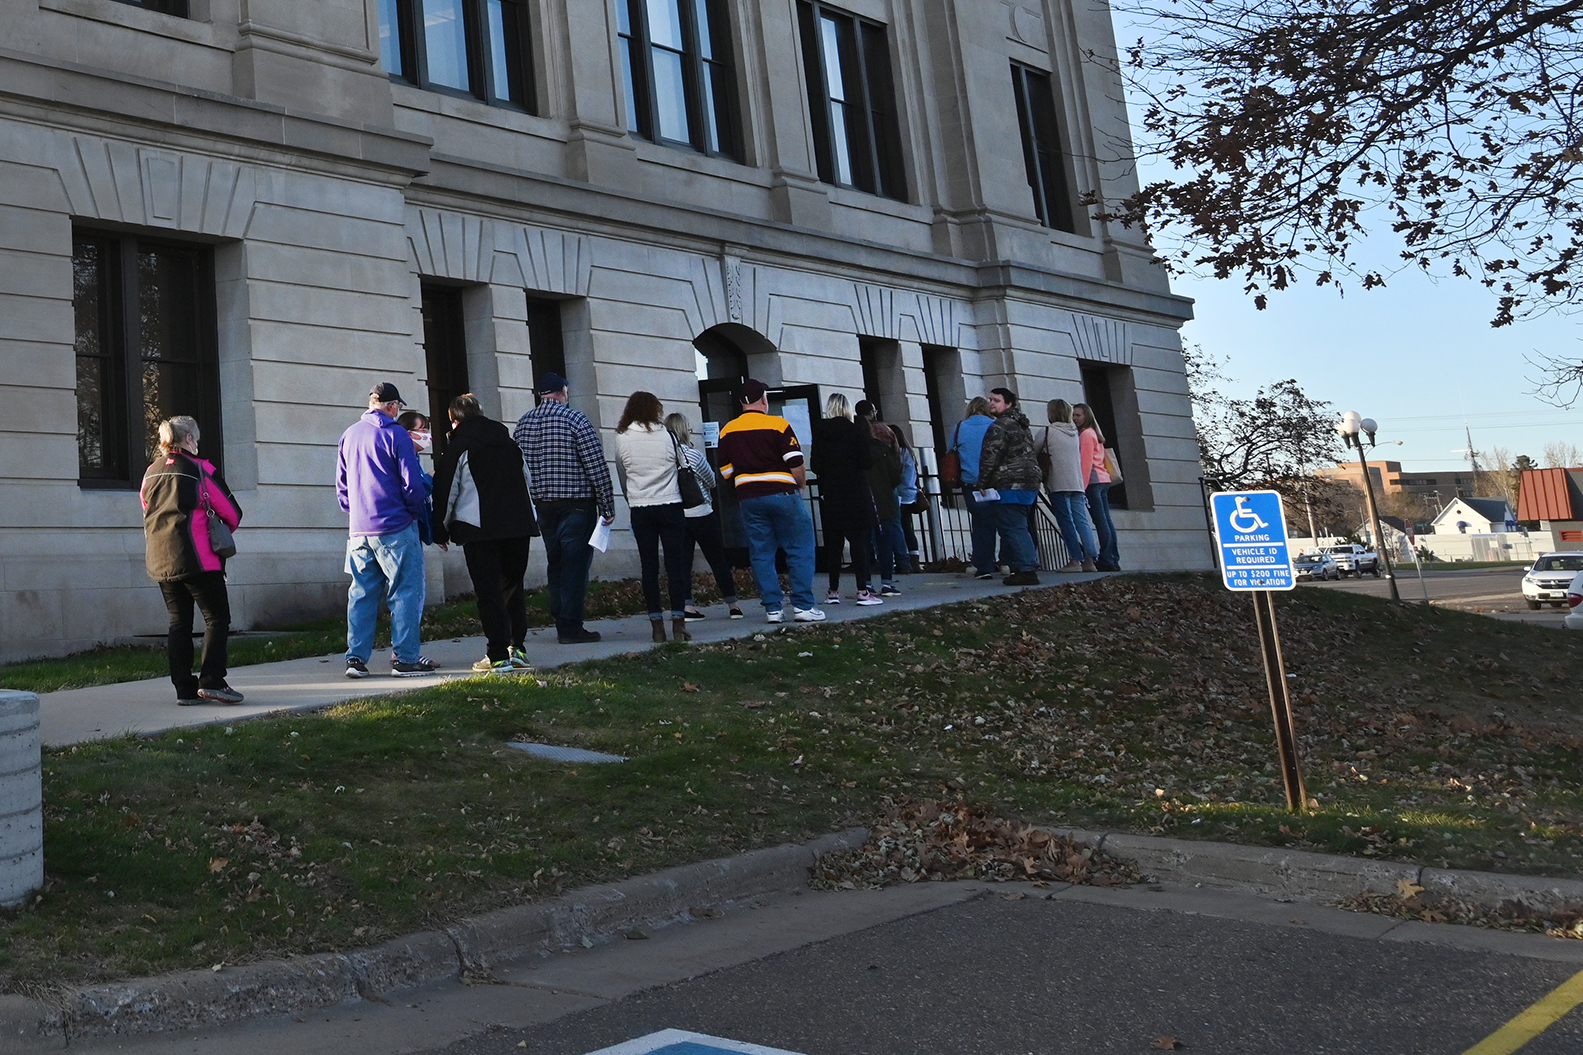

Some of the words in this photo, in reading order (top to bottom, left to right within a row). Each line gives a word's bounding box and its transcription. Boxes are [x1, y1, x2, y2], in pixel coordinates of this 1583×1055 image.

[1234, 534, 1270, 542] PARKING
[1236, 556, 1276, 564] REQUIRED
[1239, 570, 1248, 578] TO
[1251, 569, 1270, 579] $200
[1273, 569, 1290, 577] FINE
